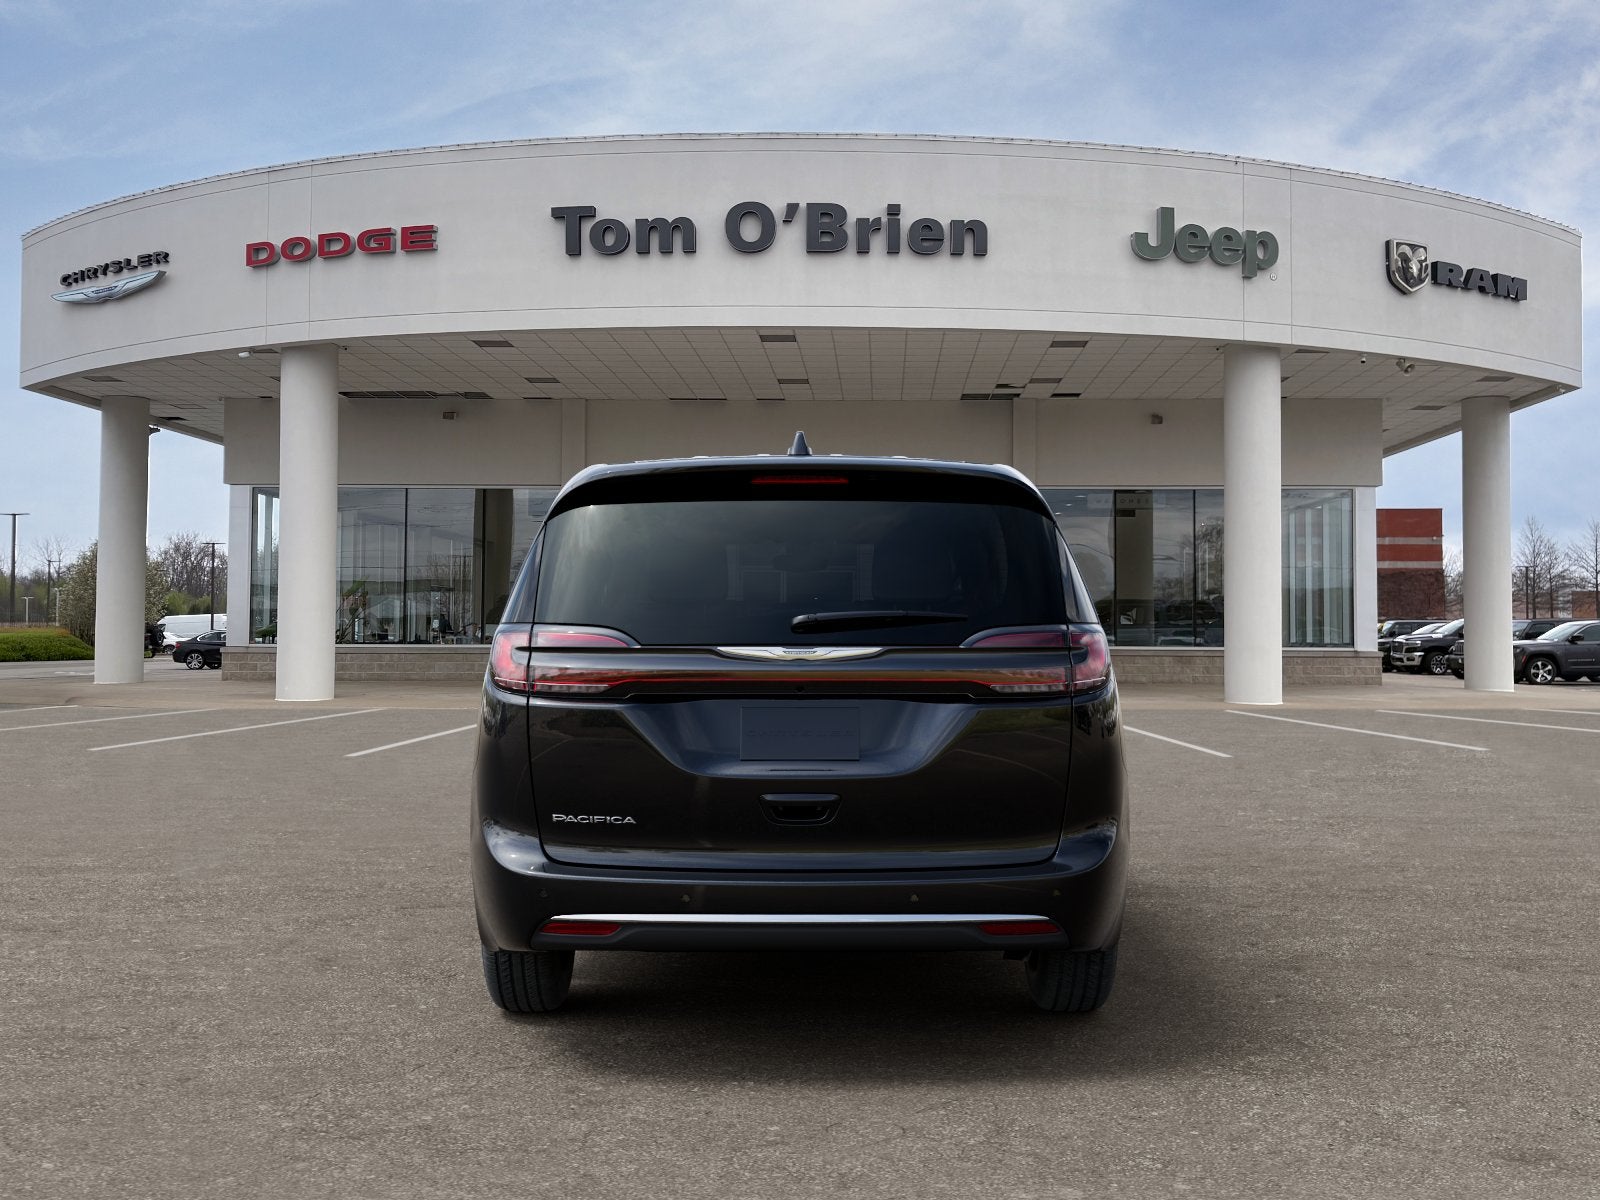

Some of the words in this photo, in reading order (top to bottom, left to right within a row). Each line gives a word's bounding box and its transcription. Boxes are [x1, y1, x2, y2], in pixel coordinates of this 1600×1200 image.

[245, 224, 438, 269] DODGE
[551, 205, 697, 256] Tom
[725, 201, 989, 256] O'Brien
[1130, 206, 1280, 279] Jeep
[60, 250, 170, 287] CHRYSLER
[1431, 260, 1528, 301] RAM
[551, 813, 637, 825] PACIFICA
